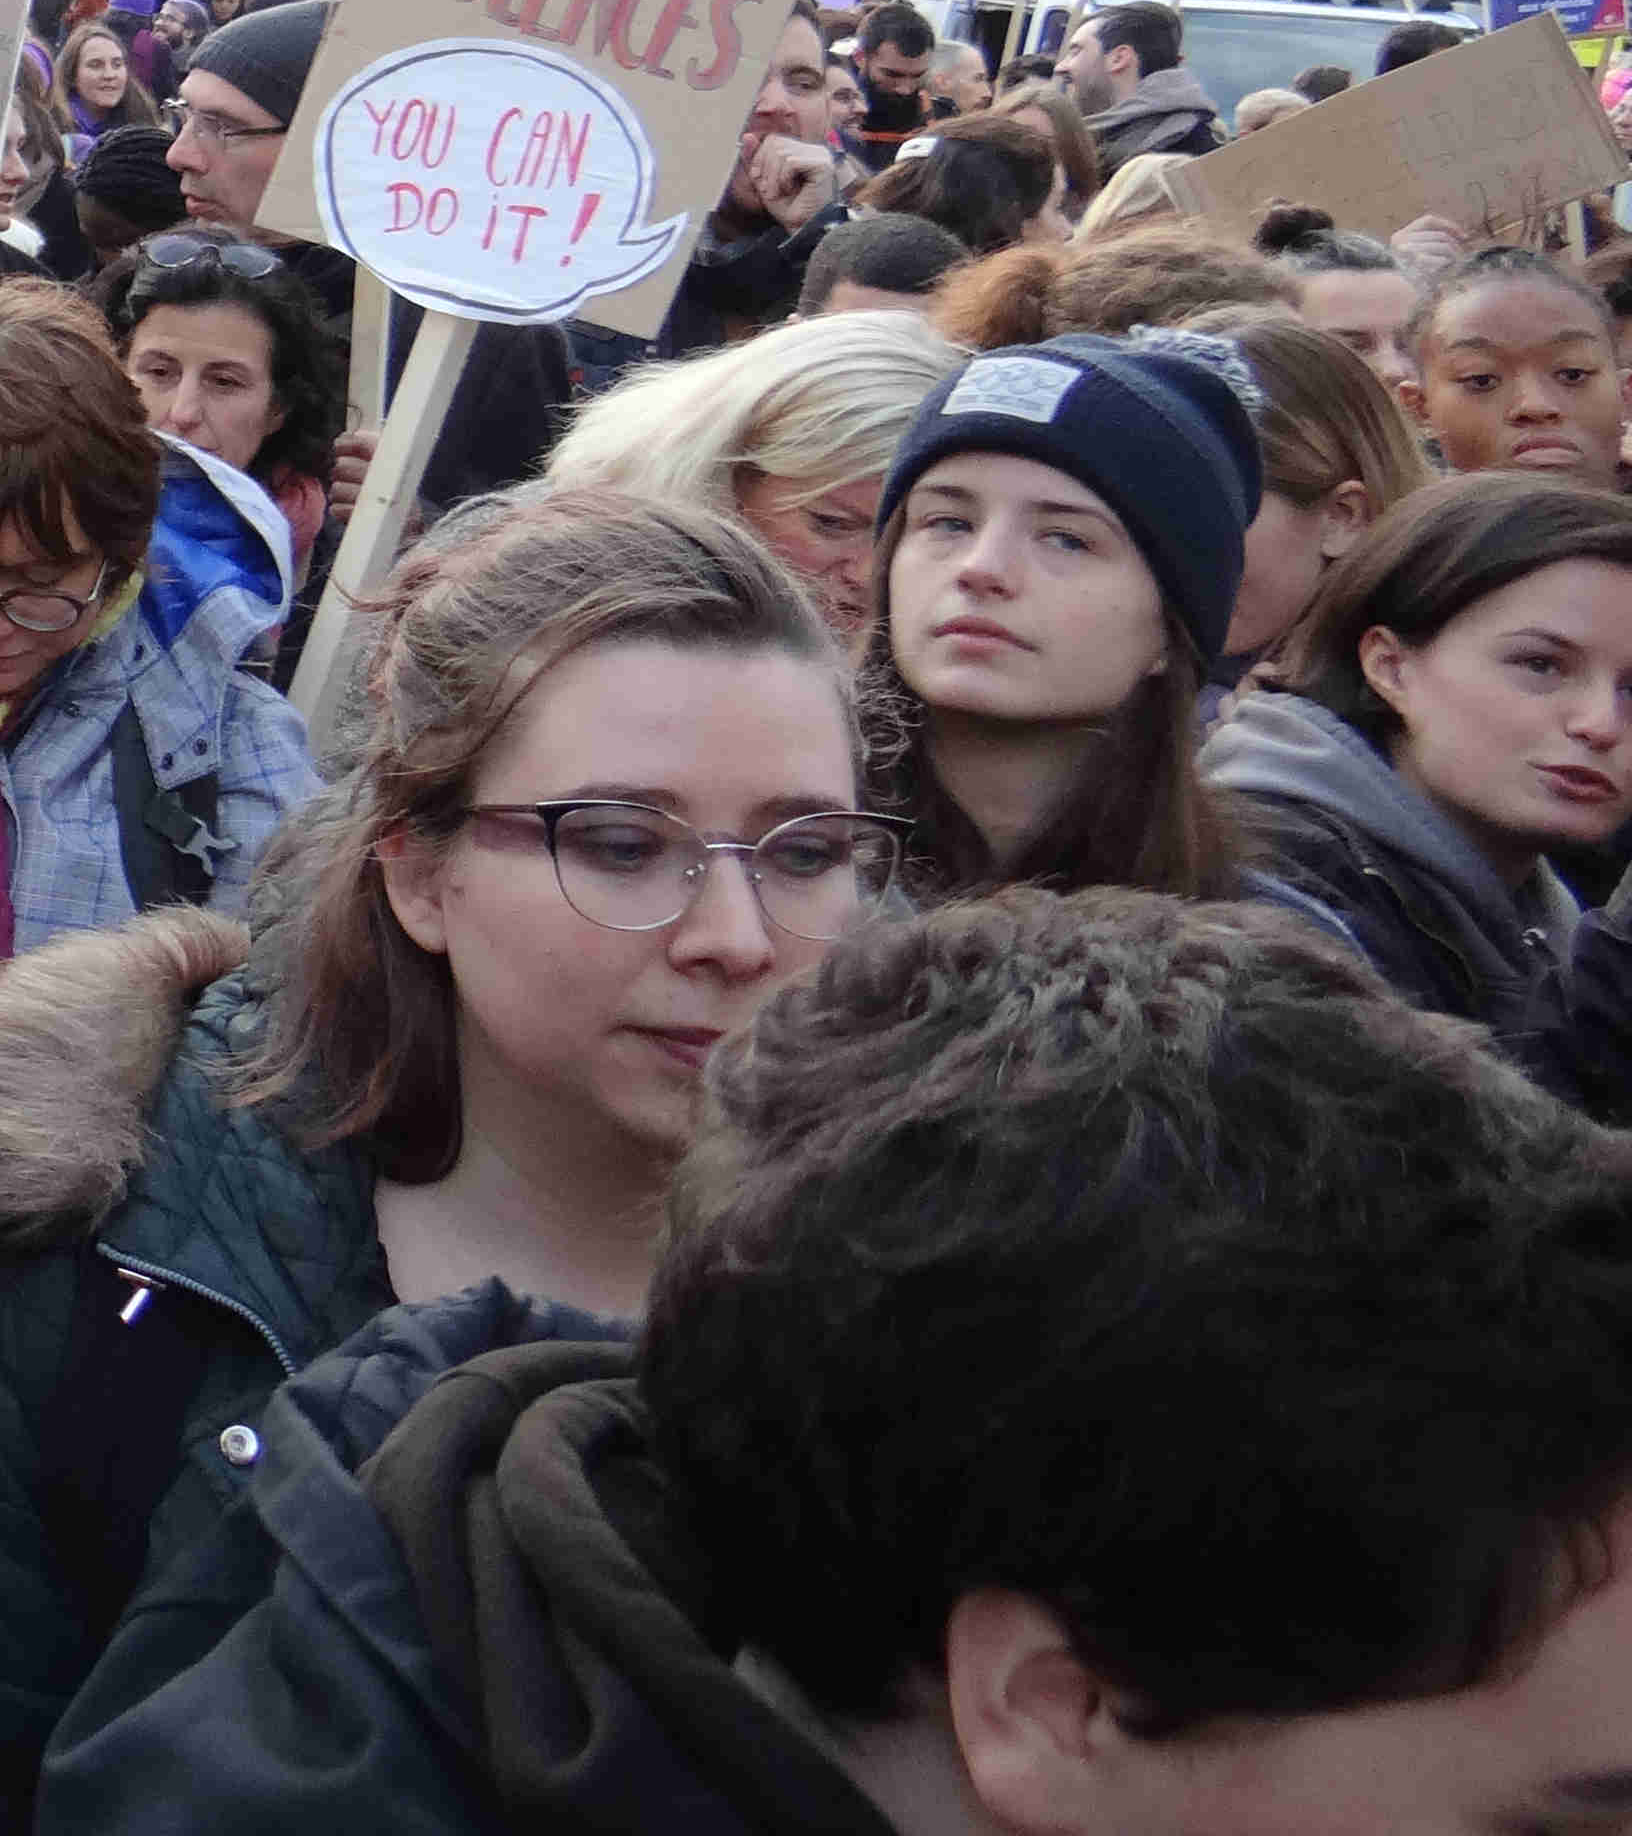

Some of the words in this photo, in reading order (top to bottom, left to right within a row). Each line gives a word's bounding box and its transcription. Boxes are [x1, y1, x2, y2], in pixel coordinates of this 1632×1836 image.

[363, 98, 455, 169] YOU
[485, 106, 592, 189] CAN
[383, 181, 461, 237] DO
